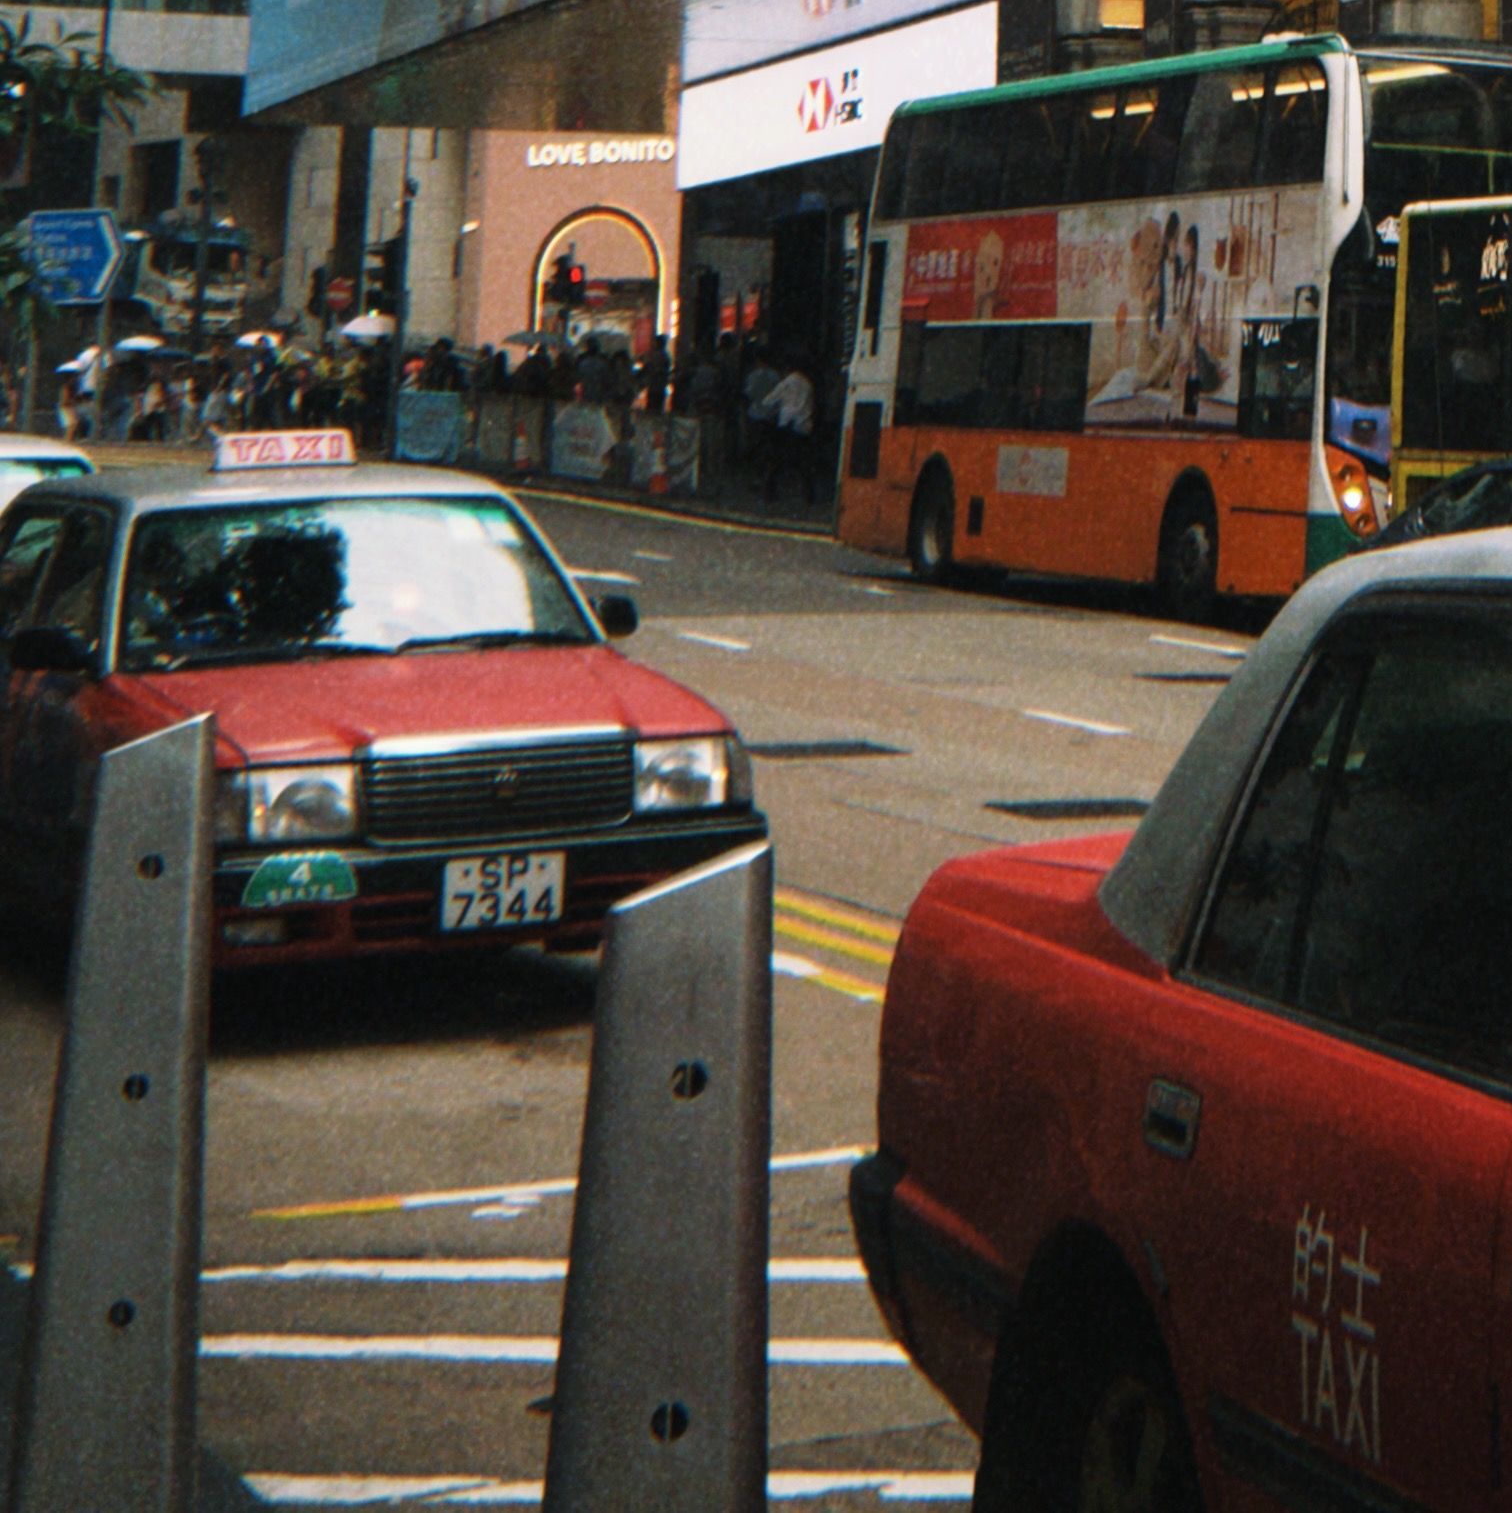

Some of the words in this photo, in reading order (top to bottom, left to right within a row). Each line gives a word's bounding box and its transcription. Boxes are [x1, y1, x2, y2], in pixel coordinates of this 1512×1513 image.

[588, 138, 675, 164] BONITO
[228, 434, 345, 463] TAXI
[288, 860, 313, 886] 4
[478, 854, 531, 890] SP
[452, 885, 556, 927] 7344
[1292, 1201, 1382, 1340] 的士
[1292, 1310, 1382, 1466] TAXI
